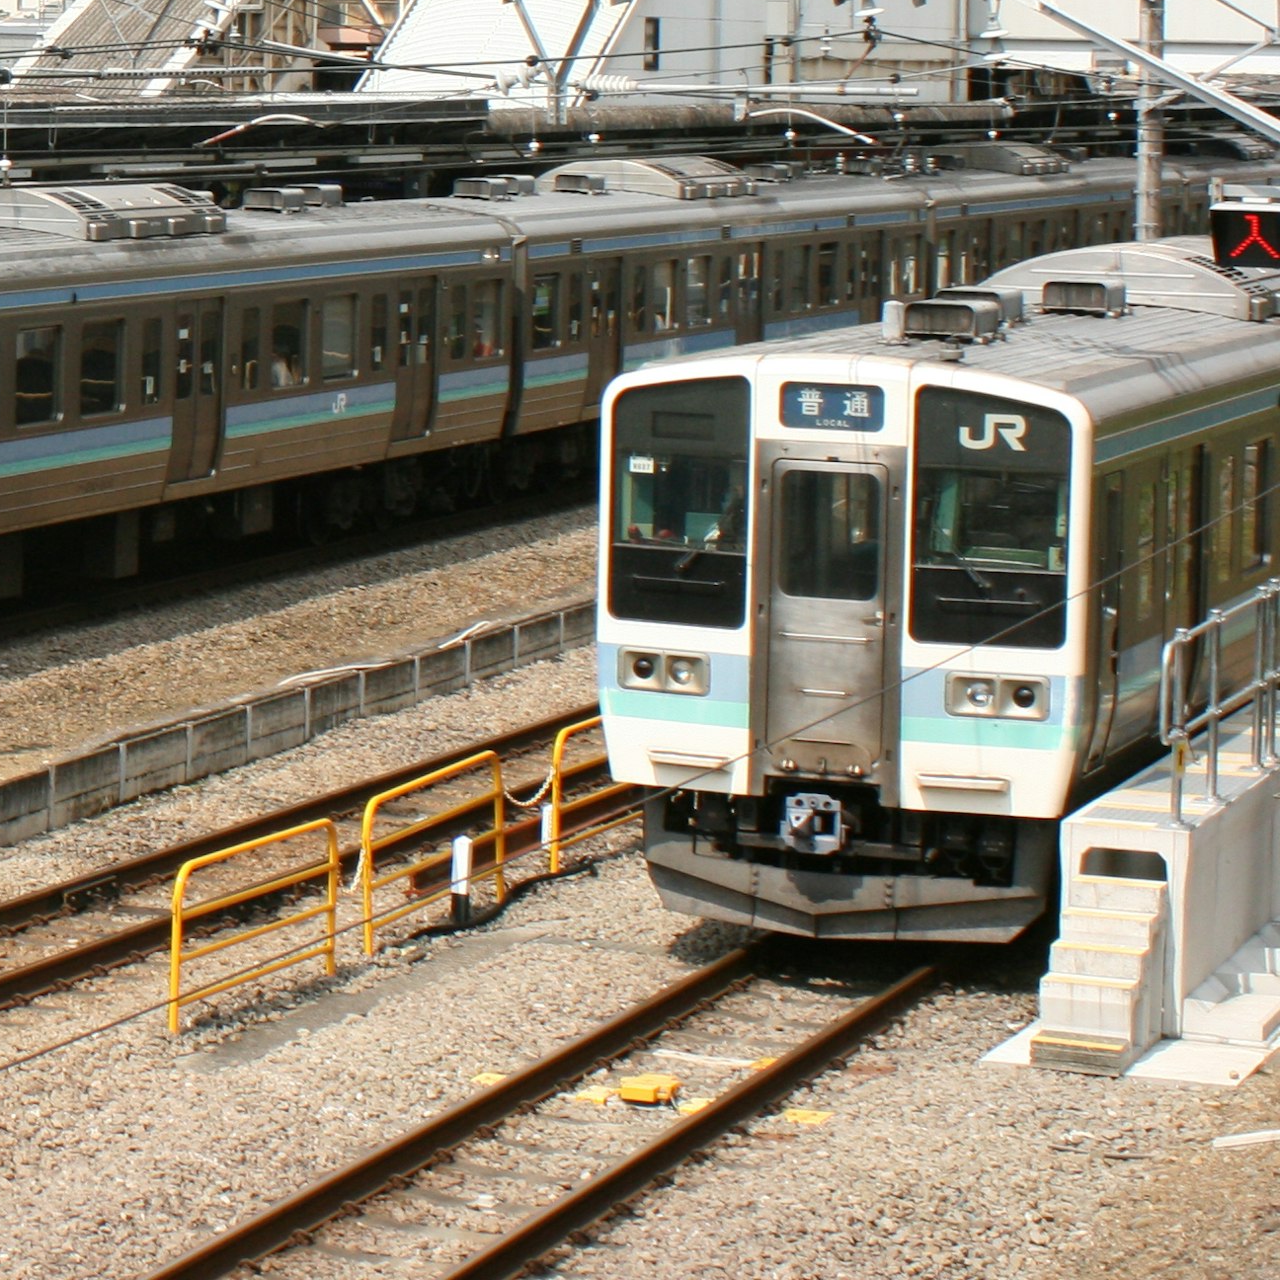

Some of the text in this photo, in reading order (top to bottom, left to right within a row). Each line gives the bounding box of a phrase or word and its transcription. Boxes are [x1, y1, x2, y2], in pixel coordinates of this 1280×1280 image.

[332, 392, 347, 414] JR
[797, 388, 871, 418] 普通
[815, 419, 850, 428] LOCAL
[958, 413, 1029, 452] JR
